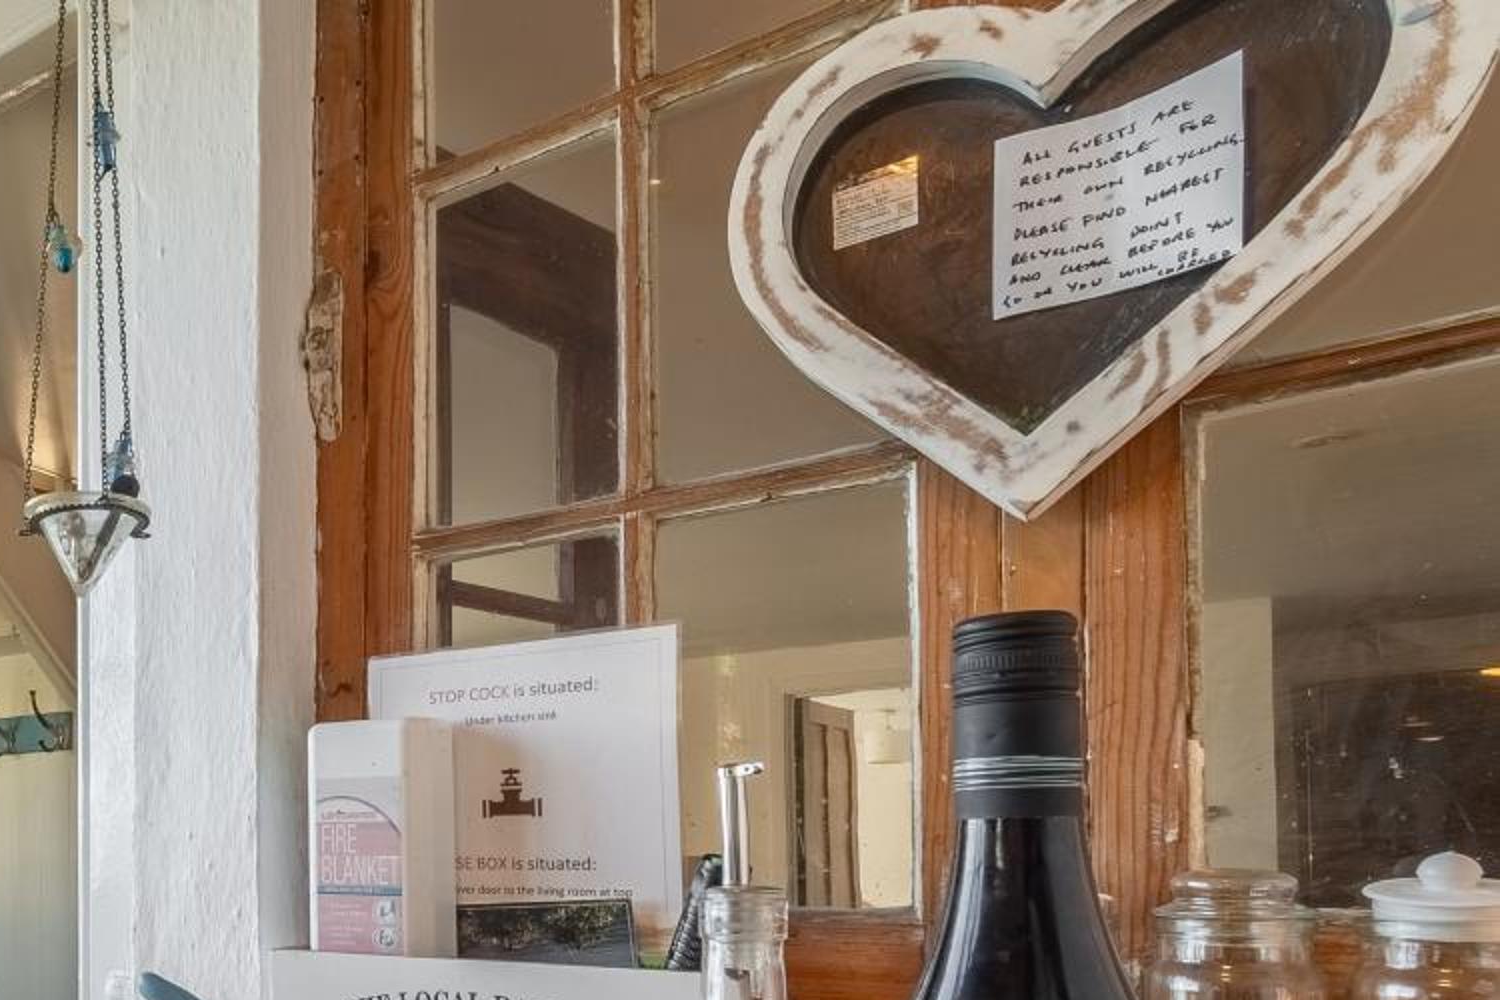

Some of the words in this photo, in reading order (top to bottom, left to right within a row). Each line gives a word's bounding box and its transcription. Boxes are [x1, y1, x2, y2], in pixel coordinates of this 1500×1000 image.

[1022, 149, 1052, 165] ALL
[1067, 121, 1137, 154] GUESTS
[1150, 100, 1195, 126] ARE
[1179, 113, 1218, 135] FOR
[1012, 194, 1064, 213] THEIR
[1083, 177, 1124, 196] OWN
[1013, 218, 1073, 241] PLEASE
[1082, 207, 1127, 228] FIND
[1145, 167, 1226, 207] NEAREST
[1008, 272, 1041, 286] AND
[1127, 228, 1196, 259] BEFORE
[1206, 217, 1235, 233] YOU
[1010, 238, 1105, 267] RECYCLING
[1130, 211, 1184, 239] POINT
[1066, 278, 1103, 293] YOU
[1119, 263, 1159, 280] WILL
[428, 689, 465, 705] STOP
[469, 685, 510, 702] COCK
[513, 685, 525, 698] is
[529, 676, 599, 698] situated:
[321, 823, 357, 854] FIRE
[321, 855, 403, 886] BLANKET
[455, 857, 474, 871] SE
[477, 857, 507, 871] BOX
[511, 856, 523, 871] is
[527, 856, 597, 872] situated:
[517, 885, 534, 896] the
